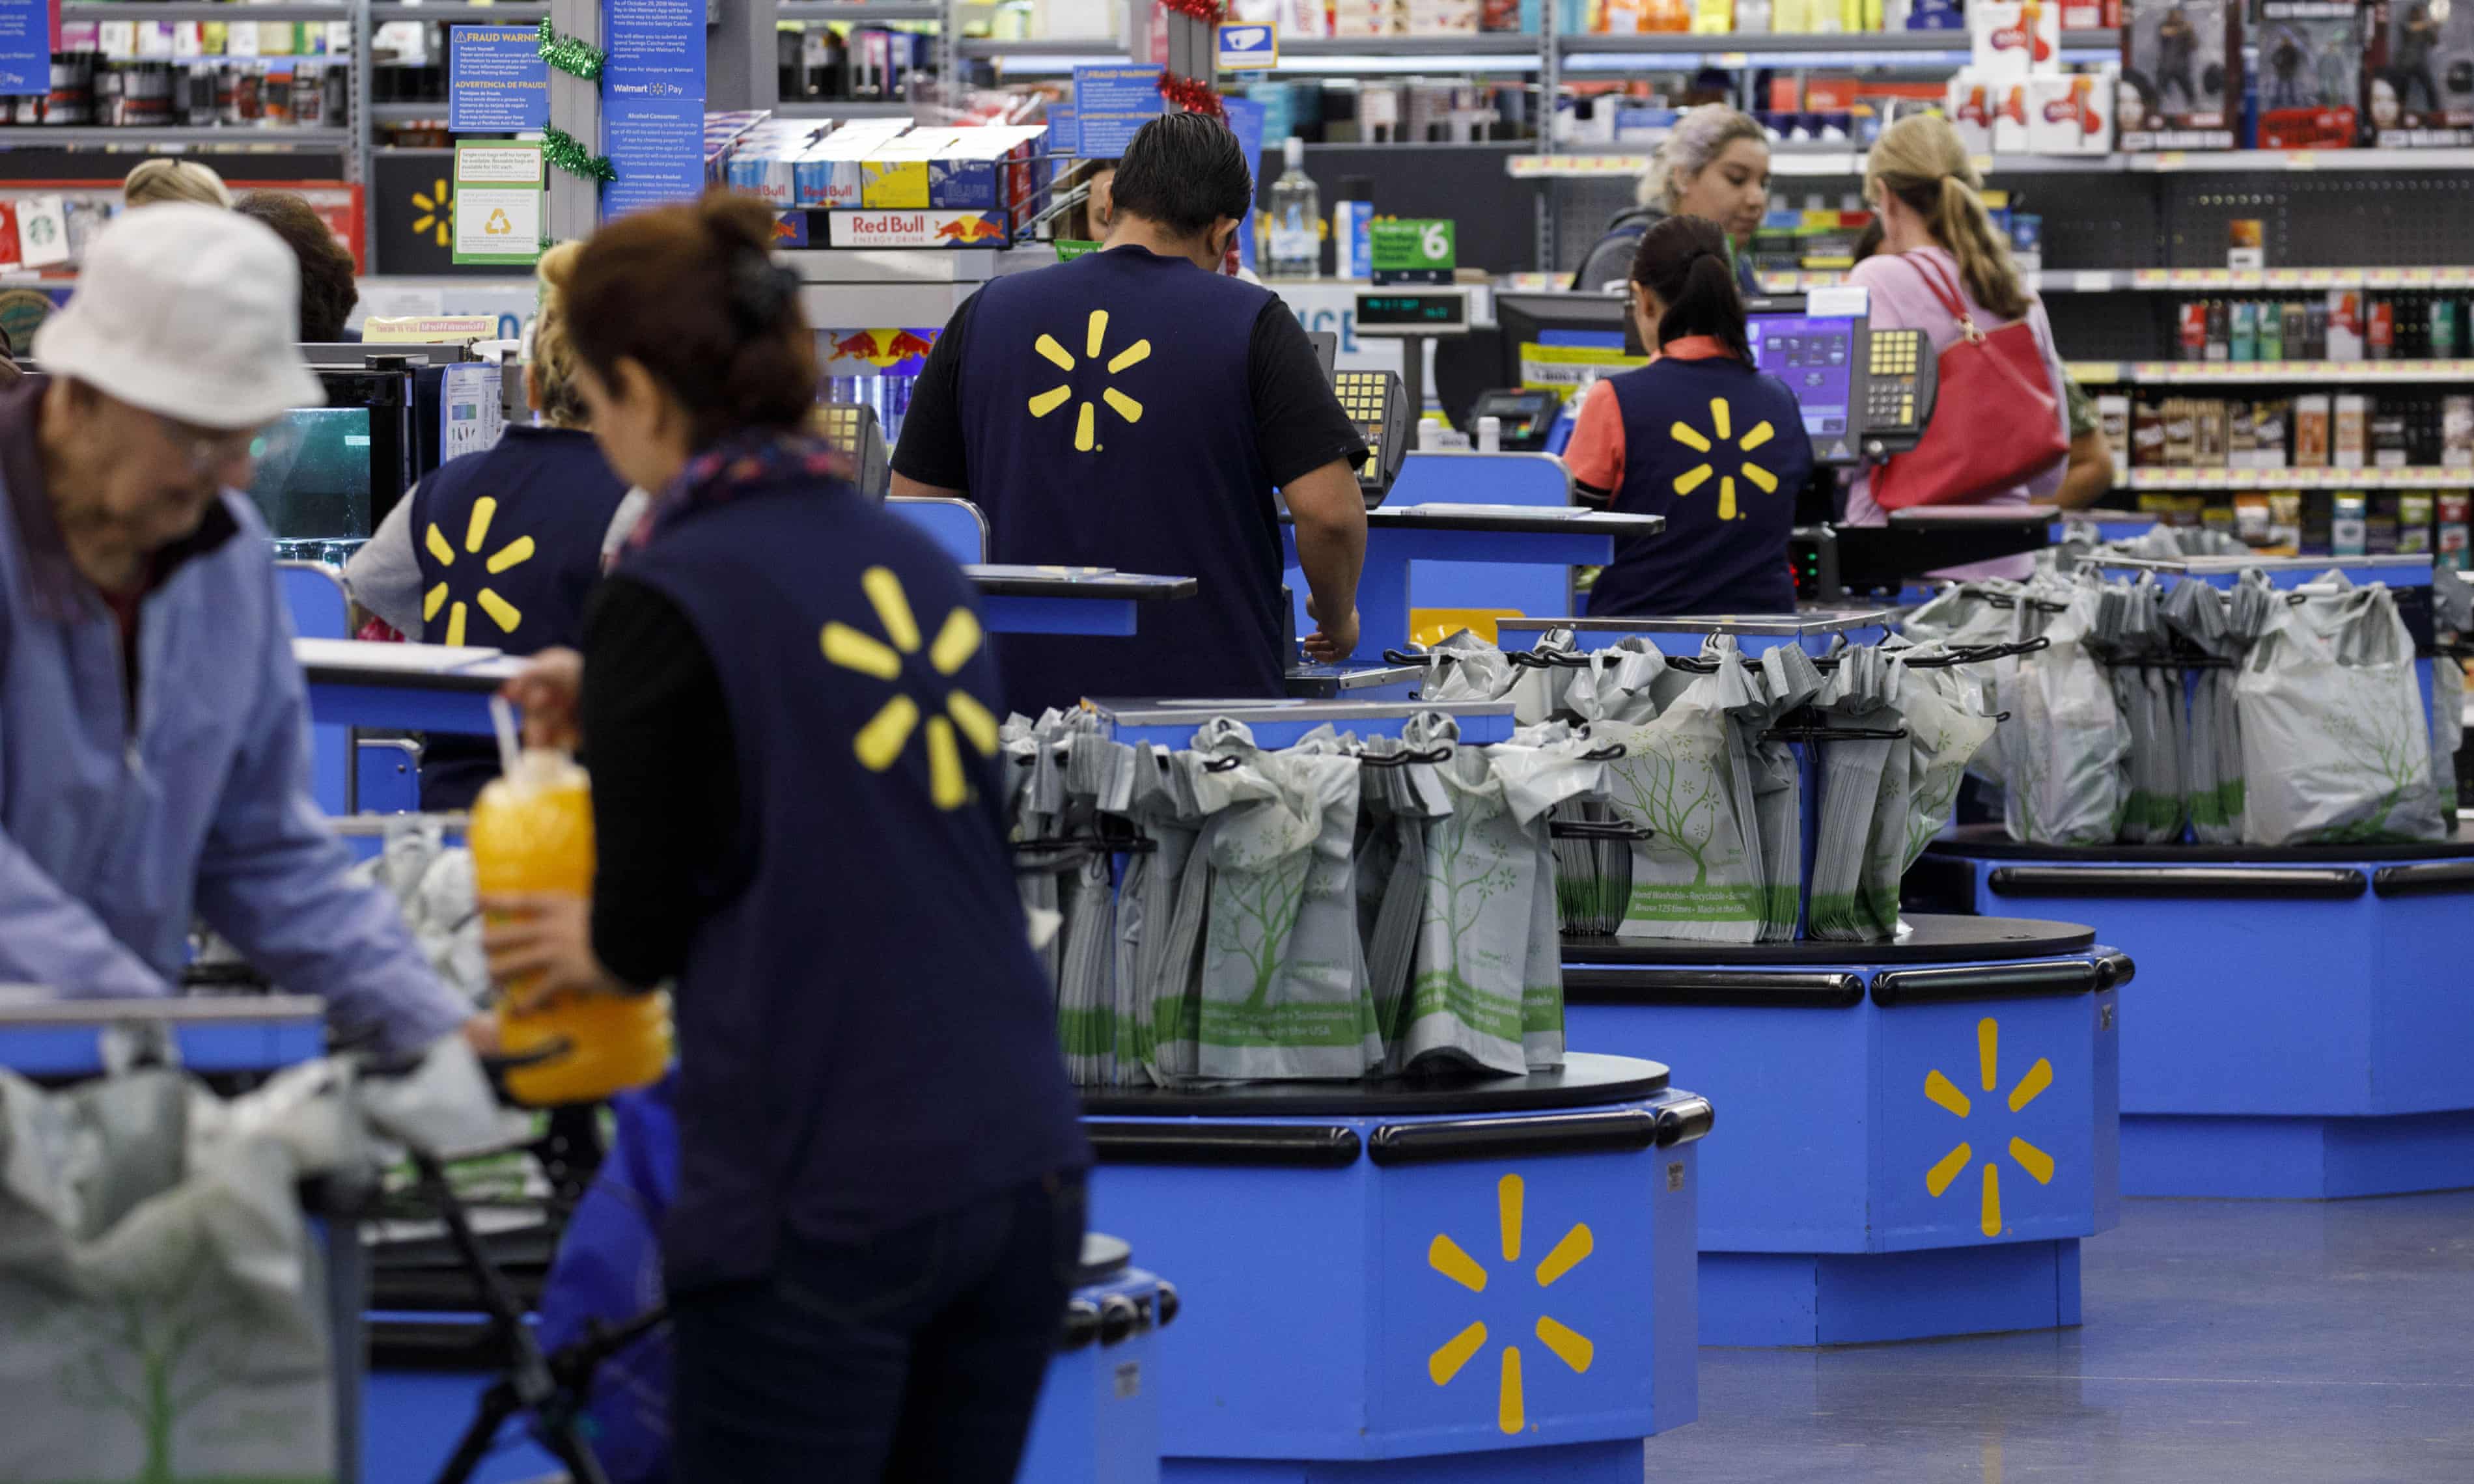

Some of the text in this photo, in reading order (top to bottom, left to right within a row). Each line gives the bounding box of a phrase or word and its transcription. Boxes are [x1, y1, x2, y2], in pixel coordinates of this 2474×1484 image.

[467, 33, 540, 42] FRAUD WARNI
[614, 84, 682, 95] Walmart Pay
[736, 185, 786, 197] Red Bull
[803, 185, 852, 197] Red Bull
[853, 216, 924, 233] Red Bull
[1634, 890, 1651, 899] Hand
[1652, 891, 1686, 900] Washable
[1689, 892, 1725, 901] Recyclable
[1294, 1009, 1355, 1021] Sustainable
[1309, 1024, 1331, 1036] USA
